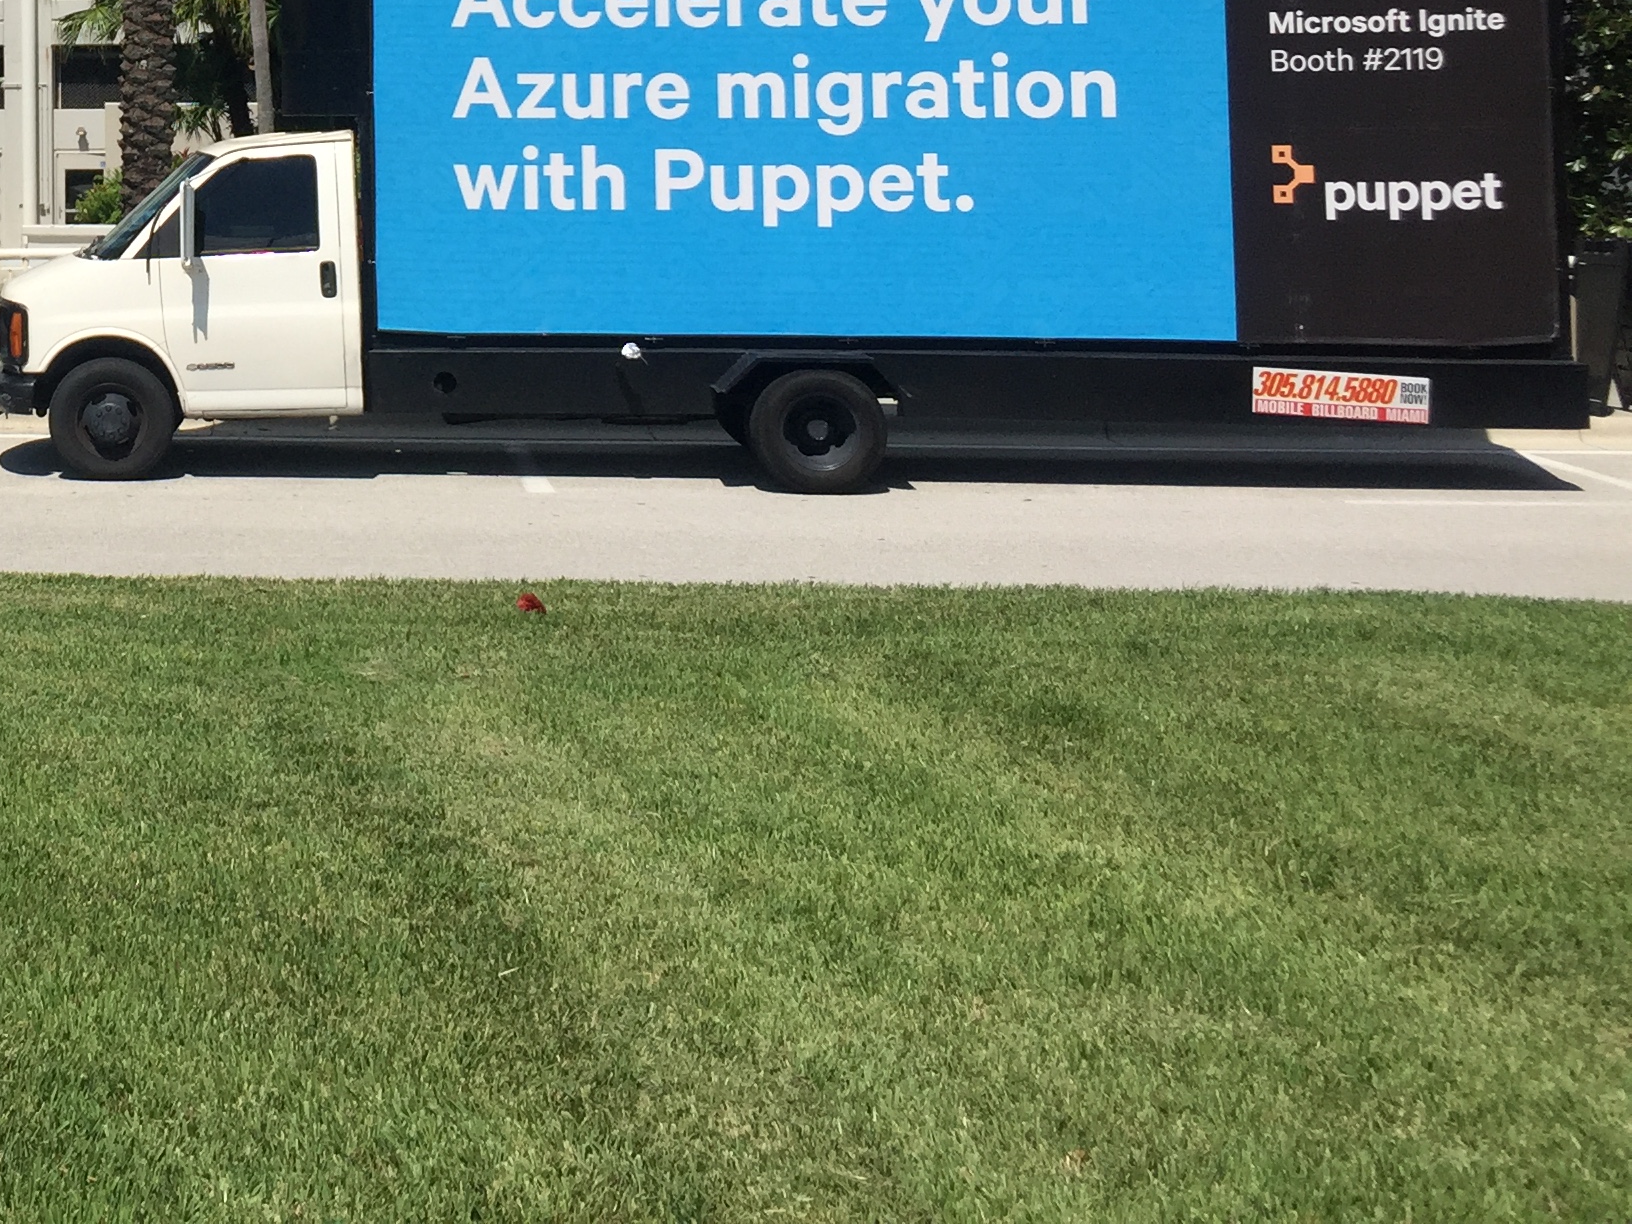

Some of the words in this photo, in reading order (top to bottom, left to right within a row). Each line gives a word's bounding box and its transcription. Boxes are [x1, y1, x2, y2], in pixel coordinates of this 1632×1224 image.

[1268, 7, 1412, 34] Microsoft
[1418, 6, 1506, 39] Ignite
[1270, 47, 1354, 73] Booth
[1362, 46, 1444, 71] #2119
[452, 57, 690, 120] Azure
[717, 51, 1117, 136] migration
[453, 144, 625, 211] with
[654, 148, 974, 228] Puppet.
[1324, 172, 1504, 221] puppet
[1253, 370, 1398, 404] 305.814.5880
[1400, 393, 1428, 405] NOW!
[1401, 382, 1428, 394] BOOK
[1257, 399, 1305, 416] MOBILE
[1311, 403, 1379, 420] BILLBOARD
[1386, 408, 1428, 424] MIAMI
